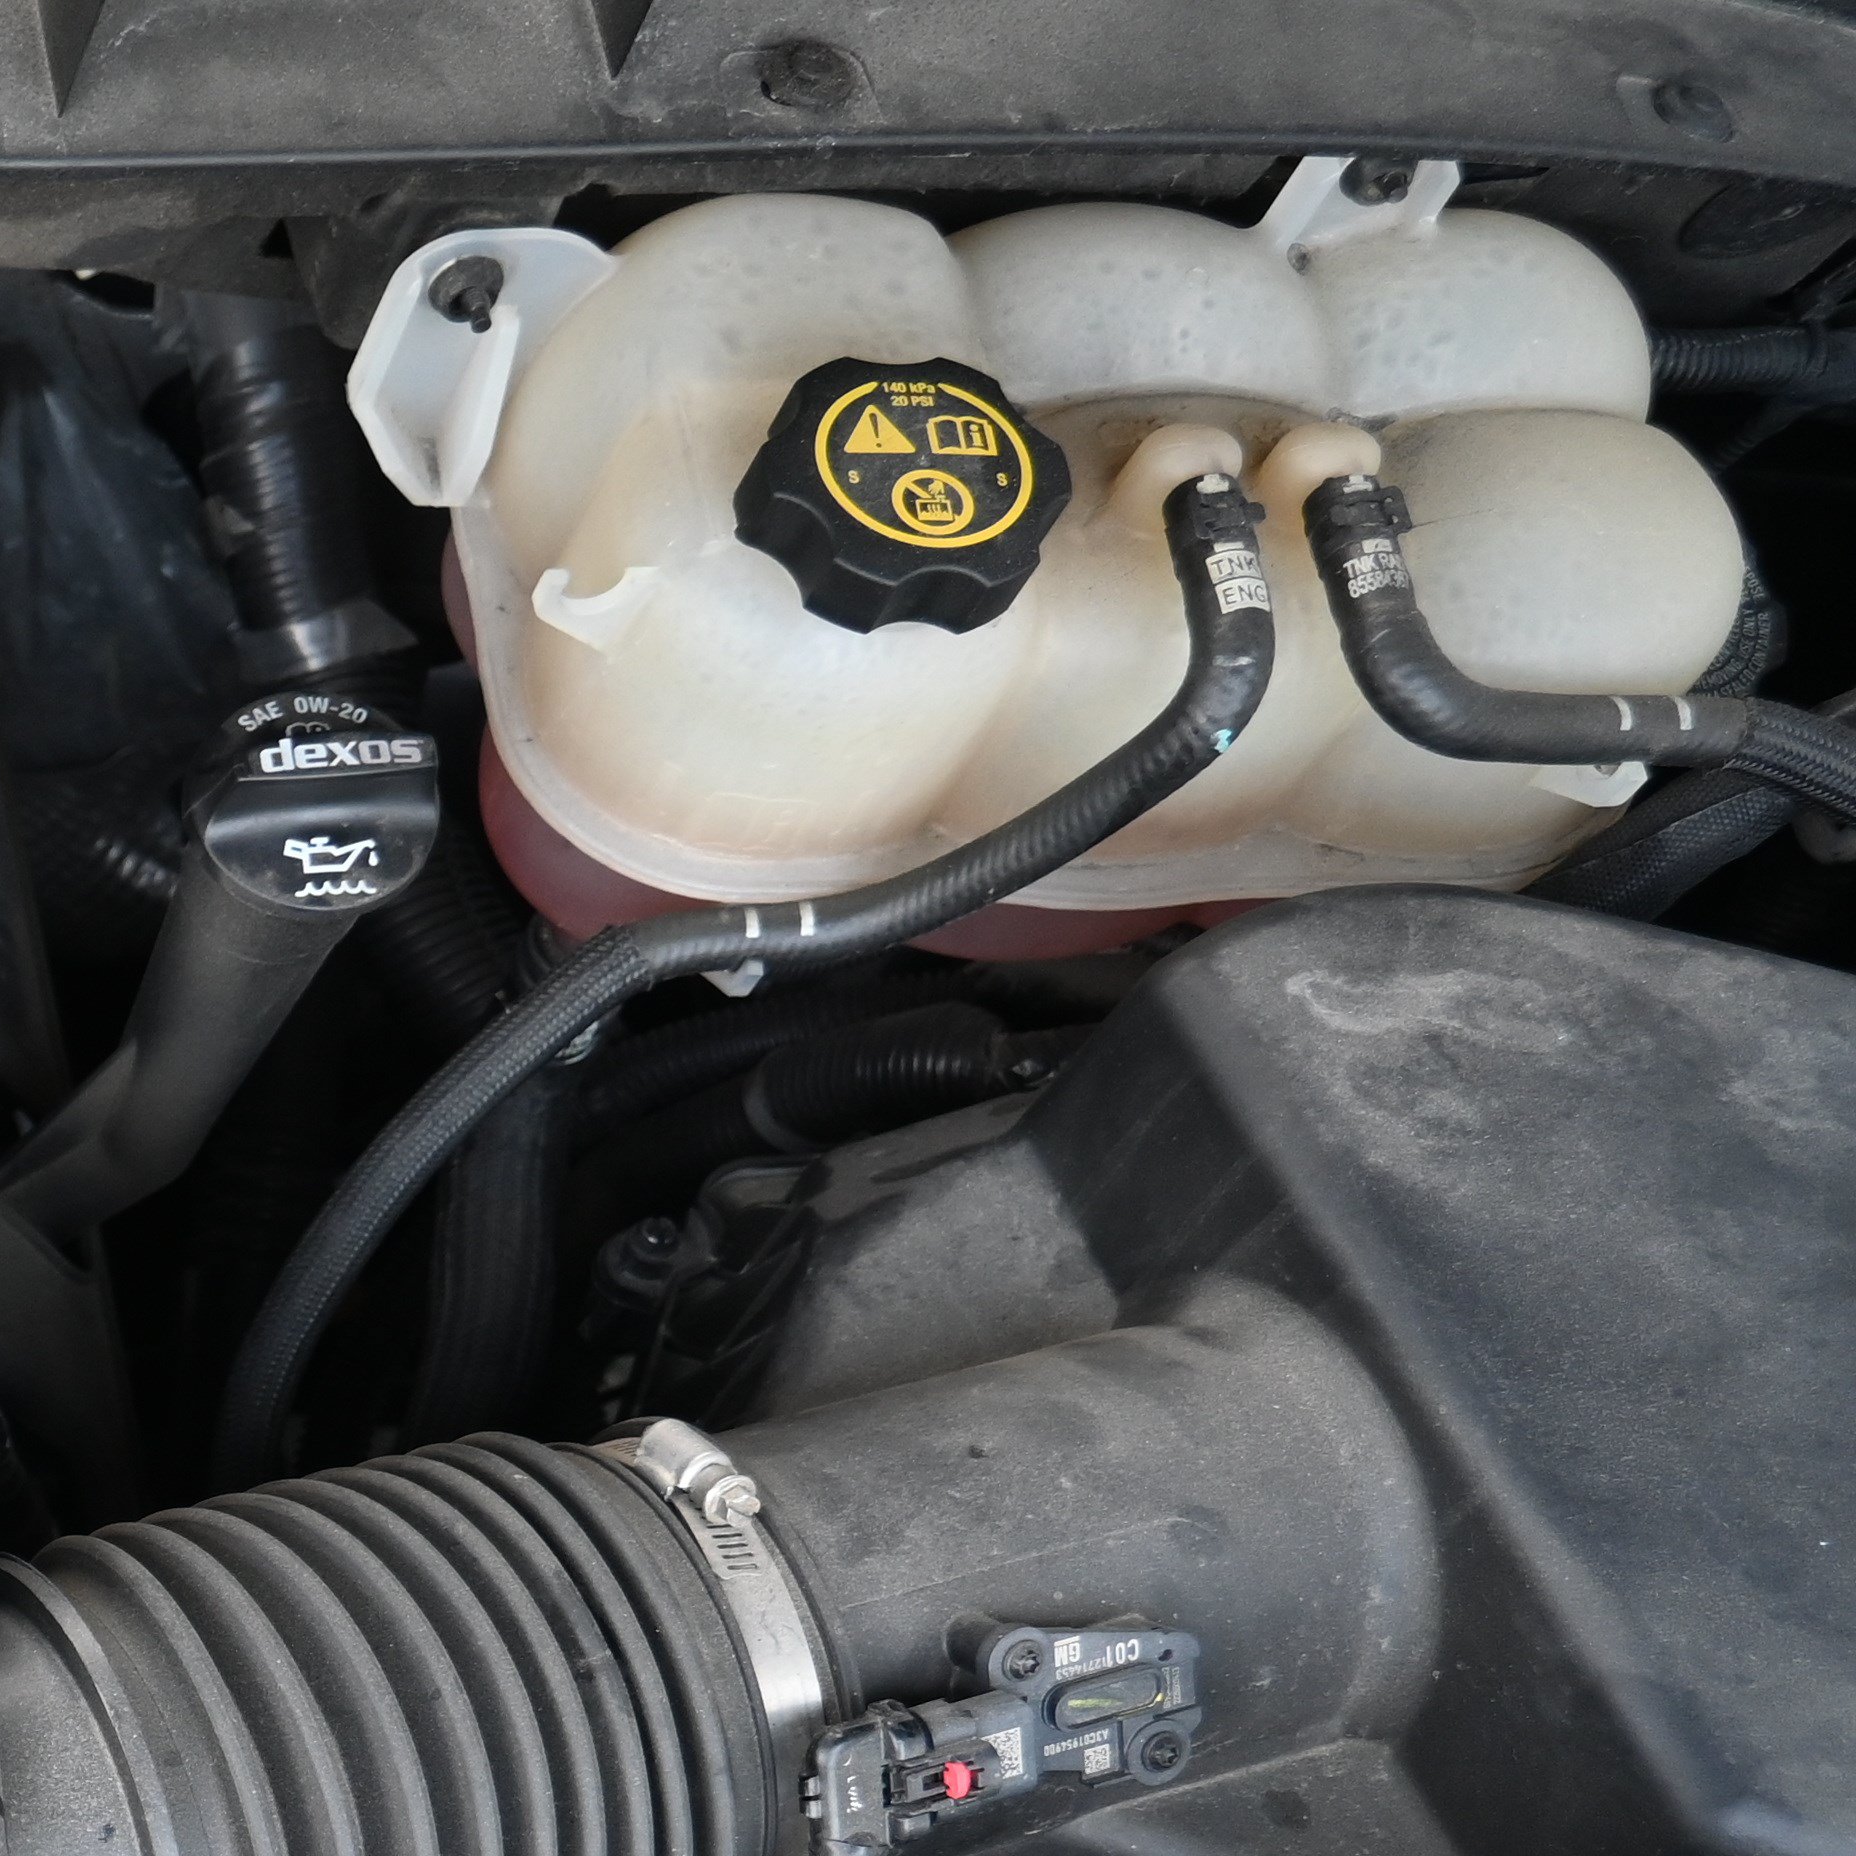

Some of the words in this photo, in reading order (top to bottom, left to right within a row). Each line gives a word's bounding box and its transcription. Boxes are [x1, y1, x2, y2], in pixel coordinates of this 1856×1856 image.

[882, 382, 907, 393] 140
[910, 382, 935, 394] kPa
[890, 395, 908, 406] 20
[911, 395, 934, 407] PSI
[1211, 557, 1259, 578] TNK
[1343, 555, 1377, 576] TNK
[1222, 586, 1267, 606] ENG
[237, 701, 284, 733] SAE
[293, 696, 369, 725] 0W-20
[259, 738, 423, 773] dexos
[1054, 1642, 1081, 1667] GM
